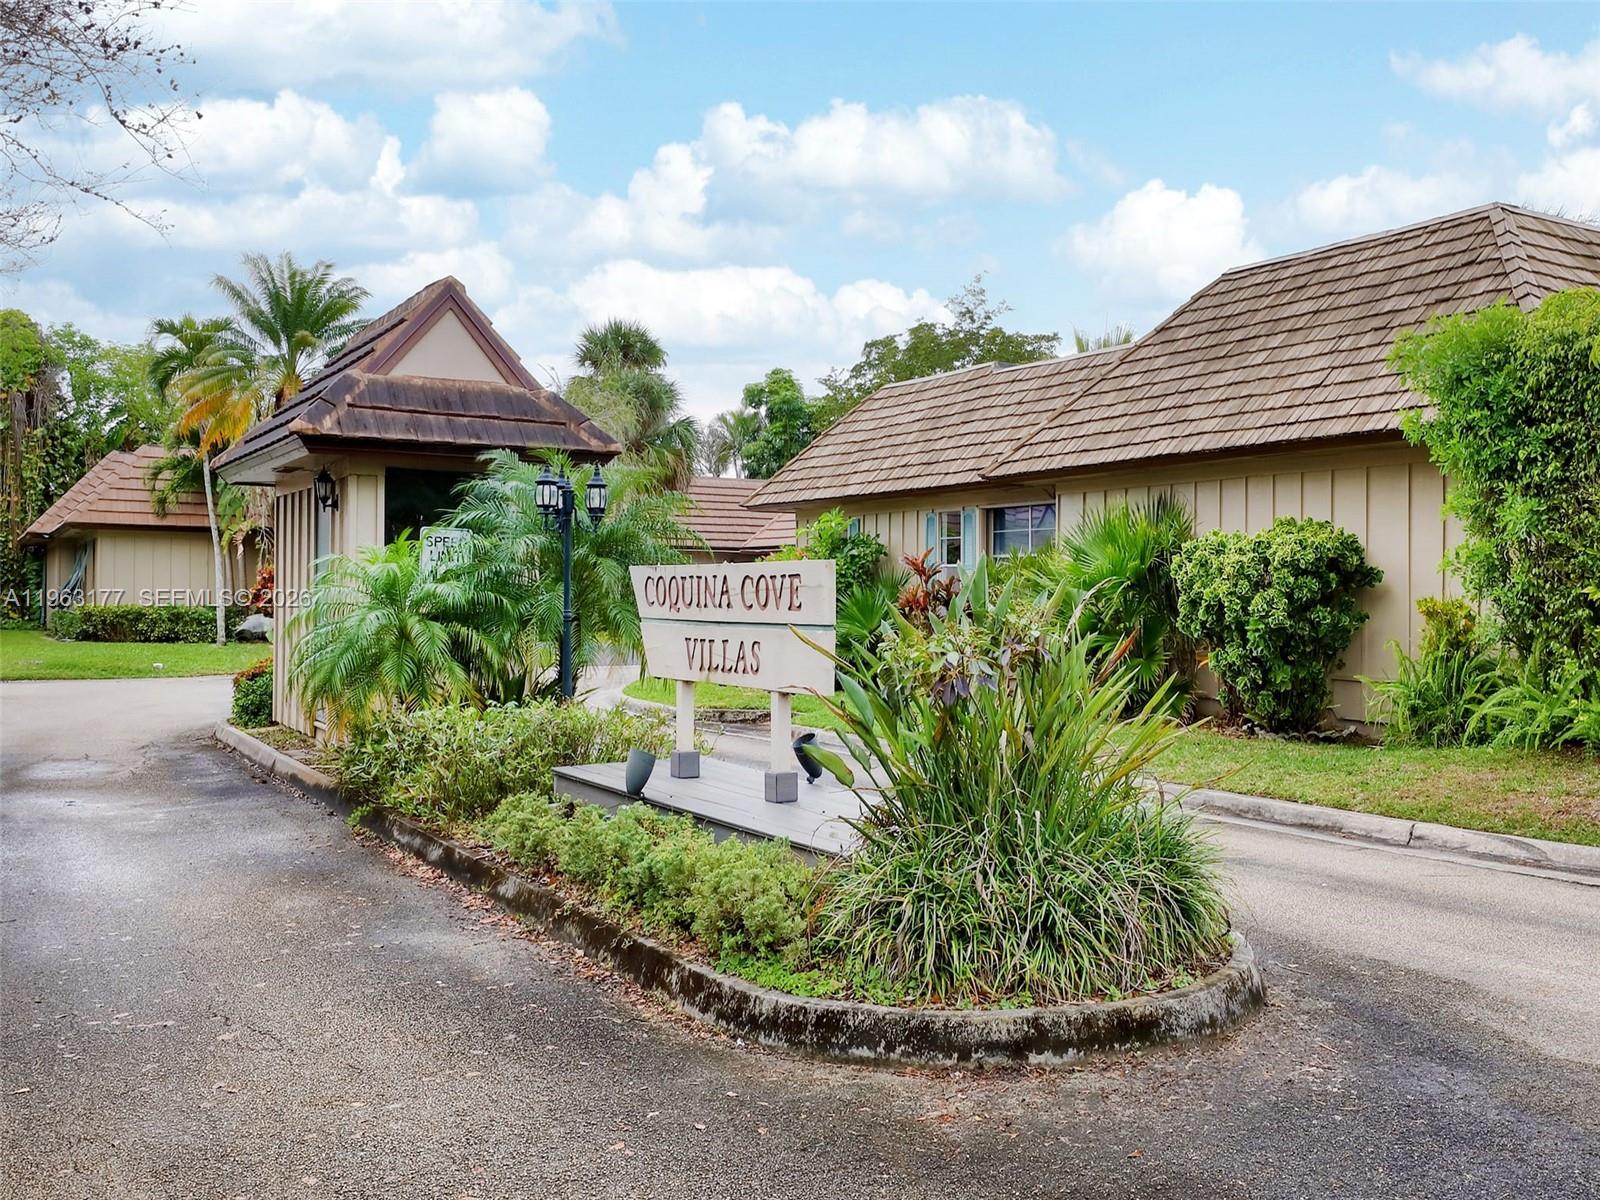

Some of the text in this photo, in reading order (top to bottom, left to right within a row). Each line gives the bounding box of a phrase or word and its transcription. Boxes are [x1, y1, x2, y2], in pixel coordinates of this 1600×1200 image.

[644, 573, 802, 613] COQUINA COVE
[685, 637, 761, 675] VILLAS
